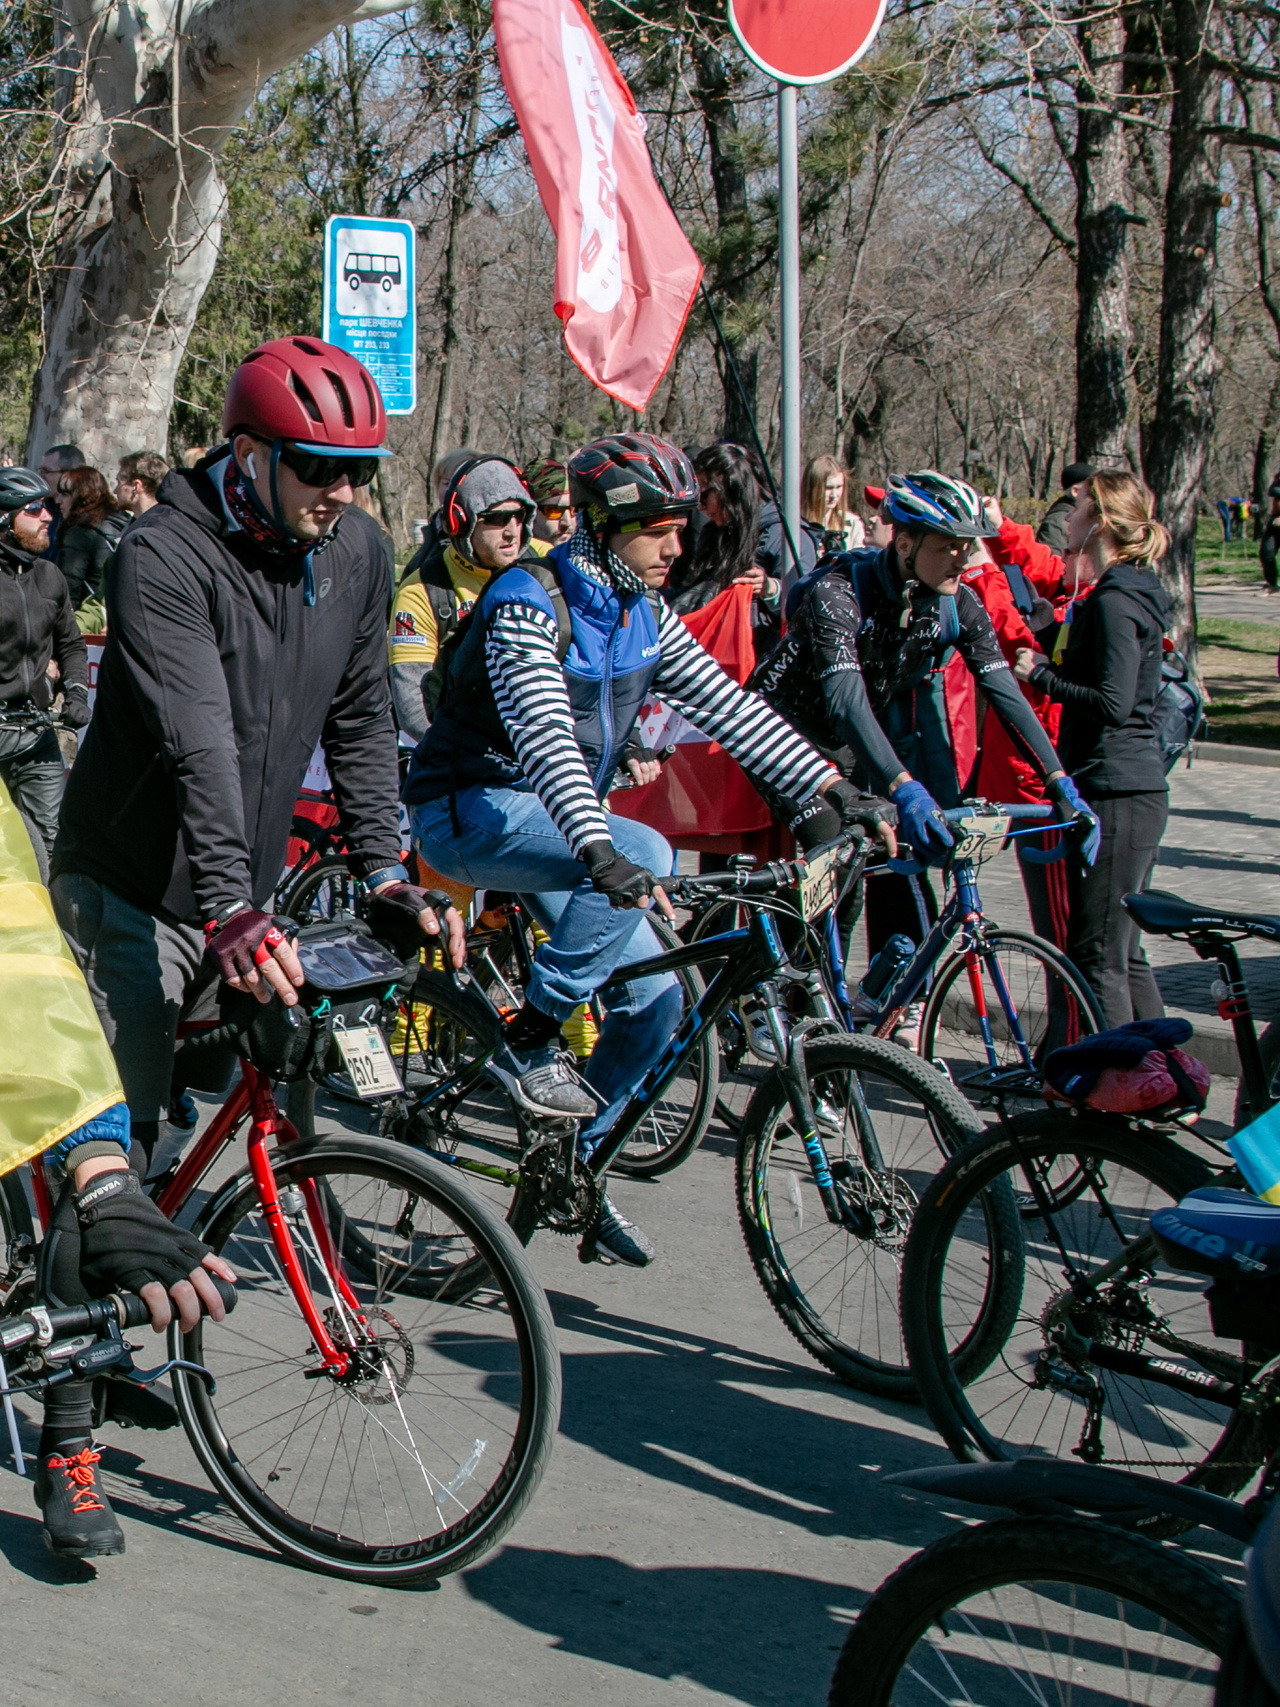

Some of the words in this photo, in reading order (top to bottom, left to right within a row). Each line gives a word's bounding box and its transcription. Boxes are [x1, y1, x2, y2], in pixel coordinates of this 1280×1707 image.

[359, 317, 403, 328] ШЕВЧЕНКА
[455, 553, 474, 572] FILA
[347, 1055, 380, 1087] 2512
[1147, 1357, 1218, 1388] Bianchi
[372, 1452, 519, 1562] BONTRAGER
